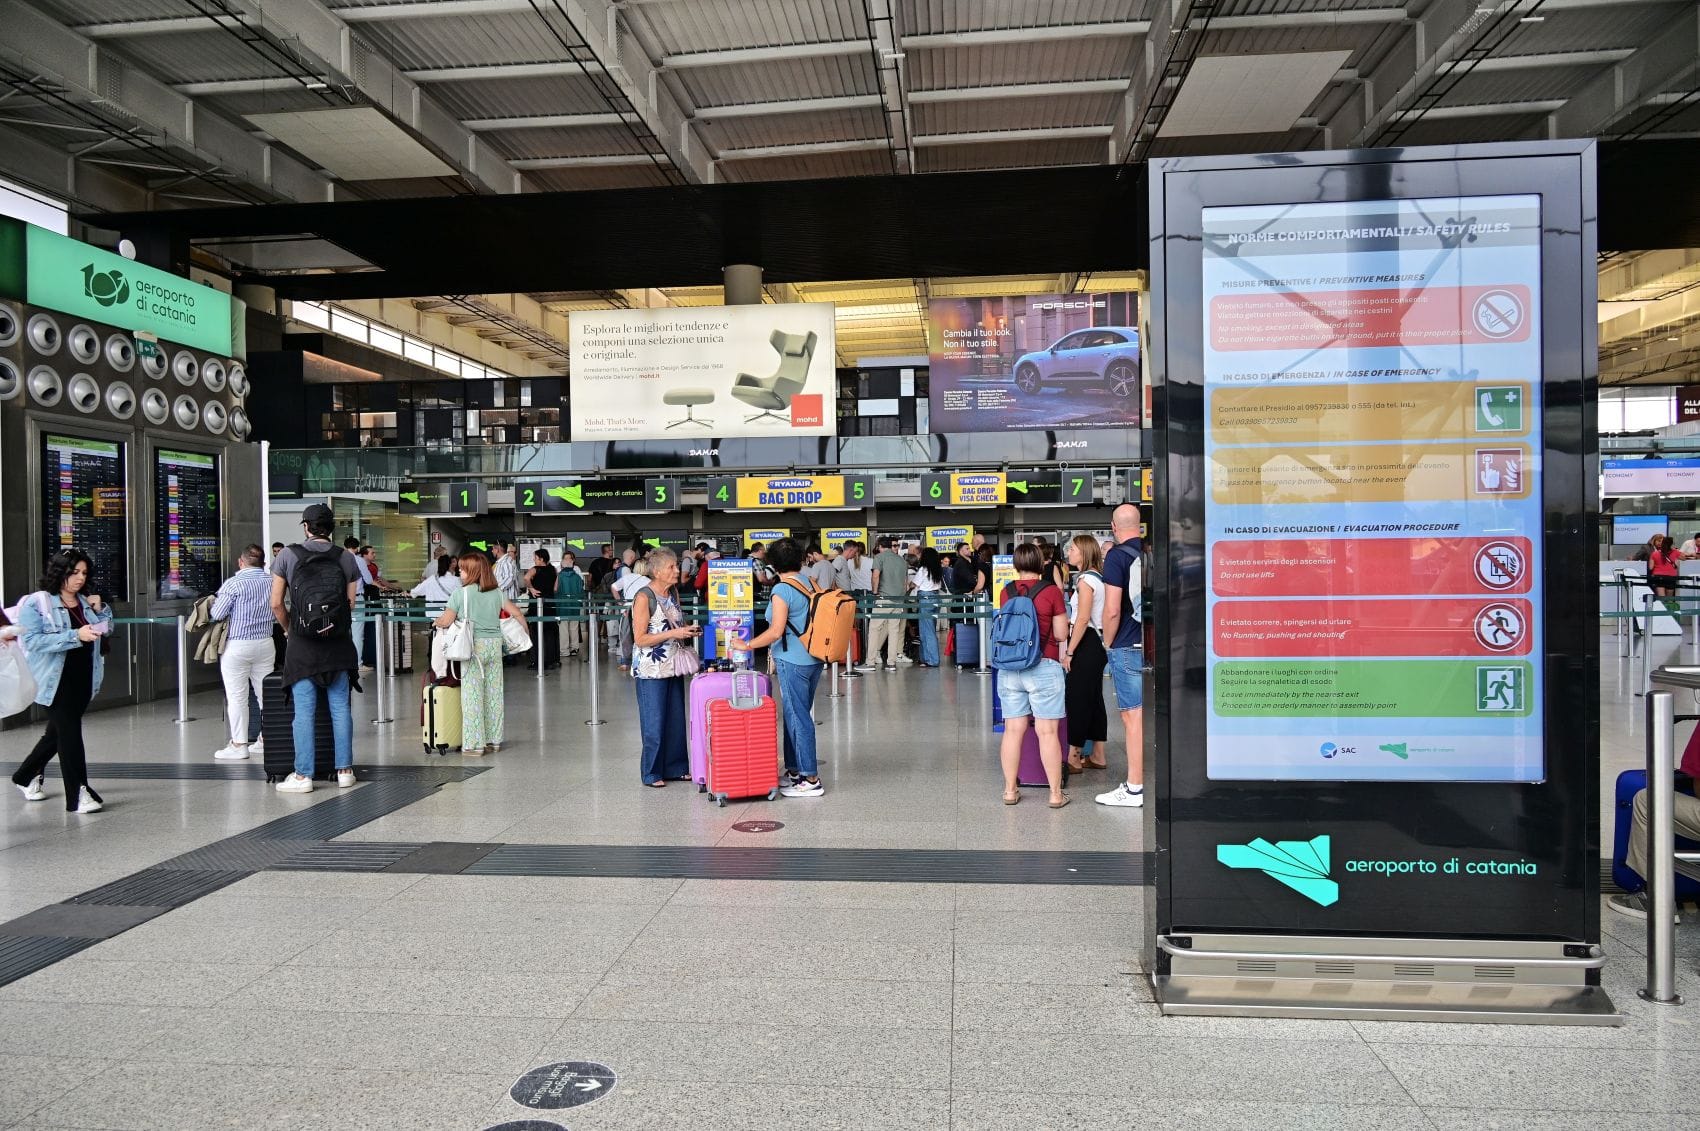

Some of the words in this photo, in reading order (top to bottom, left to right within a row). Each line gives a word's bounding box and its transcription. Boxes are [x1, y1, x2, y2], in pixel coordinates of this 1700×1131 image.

[1228, 233, 1275, 244] NORME
[1277, 228, 1406, 241] COMPORTAMENTALI
[1408, 228, 1413, 237] /
[1415, 224, 1466, 236] SAFETY
[1468, 222, 1511, 234] RULES
[1222, 280, 1256, 288] MISURE
[1257, 278, 1312, 287] PREVENTIVE
[1319, 275, 1374, 284] PREVENTIVE
[1375, 274, 1425, 283] MEASURES
[136, 280, 195, 309] aeroporto
[136, 295, 147, 311] di
[152, 301, 196, 325] catania
[1032, 301, 1106, 310] PORSCHE
[583, 324, 621, 336] Esplora
[623, 323, 632, 333] le
[634, 322, 673, 335] migliori
[675, 321, 721, 332] tendenze
[943, 329, 972, 338] Cambia
[973, 329, 978, 337] il
[979, 329, 993, 337] tuo
[582, 337, 626, 349] componi
[628, 338, 646, 346] una
[648, 335, 695, 345] selezione
[696, 334, 724, 344] unica
[943, 340, 959, 348] Non
[960, 340, 965, 348] il
[981, 339, 999, 347] stile.
[583, 352, 589, 360] e
[590, 348, 637, 362] originale.
[1234, 373, 1258, 381] CASO
[1272, 371, 1326, 380] EMERGENZA
[1333, 370, 1343, 378] IN
[1345, 369, 1369, 377] CASE
[1371, 369, 1383, 377] OF
[1384, 367, 1441, 377] EMERGENCY
[1265, 404, 1296, 412] Presidio
[715, 485, 729, 503] 4
[853, 482, 865, 499] 5
[929, 481, 942, 498] 6
[962, 487, 976, 495] BAG
[1071, 478, 1084, 496] 7
[460, 490, 468, 507] 1
[523, 489, 535, 506] 2
[585, 490, 613, 499] aeroporto
[655, 486, 666, 504] 3
[759, 492, 784, 505] BAG
[787, 491, 822, 504] DROP
[975, 494, 999, 502] CHECK
[1236, 526, 1260, 534] CASO
[1262, 526, 1271, 534] DI
[1273, 525, 1335, 533] EVACUAZIONE
[1343, 524, 1401, 532] EVACUATION
[1403, 523, 1460, 532] PROCEDURE
[1226, 618, 1251, 626] vietato
[1283, 618, 1317, 627] spingersi
[1233, 631, 1265, 639] Running,
[1266, 630, 1296, 640] pushing
[1297, 630, 1311, 638] and
[1313, 630, 1345, 640] shouting
[1275, 669, 1298, 678] luoghi
[1221, 678, 1248, 687] Seguire
[1244, 691, 1290, 699] immediately
[1291, 691, 1301, 699] by
[1272, 702, 1299, 710] orderly
[1339, 702, 1375, 710] assembly
[1376, 702, 1397, 710] point
[1341, 746, 1356, 754] SAC
[1345, 858, 1437, 878] aeroporto
[1443, 858, 1459, 874] di
[1466, 858, 1537, 875] catania
